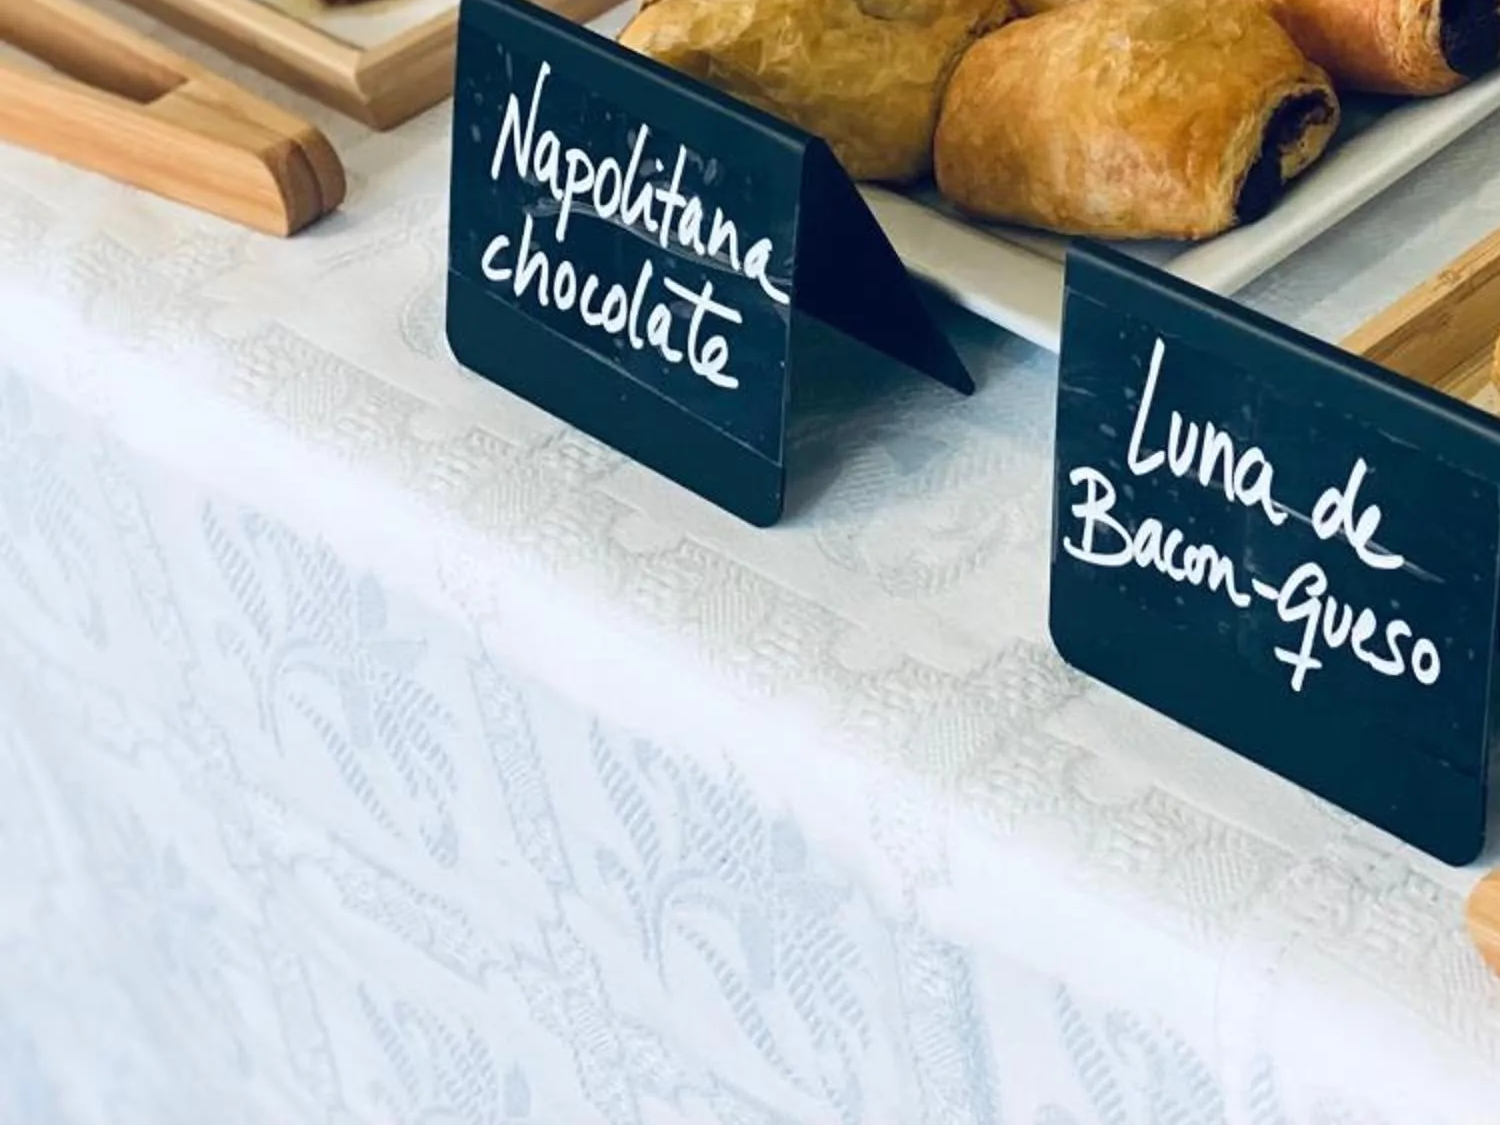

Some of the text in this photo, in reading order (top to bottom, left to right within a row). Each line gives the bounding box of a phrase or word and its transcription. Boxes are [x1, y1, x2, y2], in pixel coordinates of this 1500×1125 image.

[491, 61, 790, 305] Napolitana
[481, 213, 742, 388] chocolate
[1127, 337, 1404, 569] Luna de
